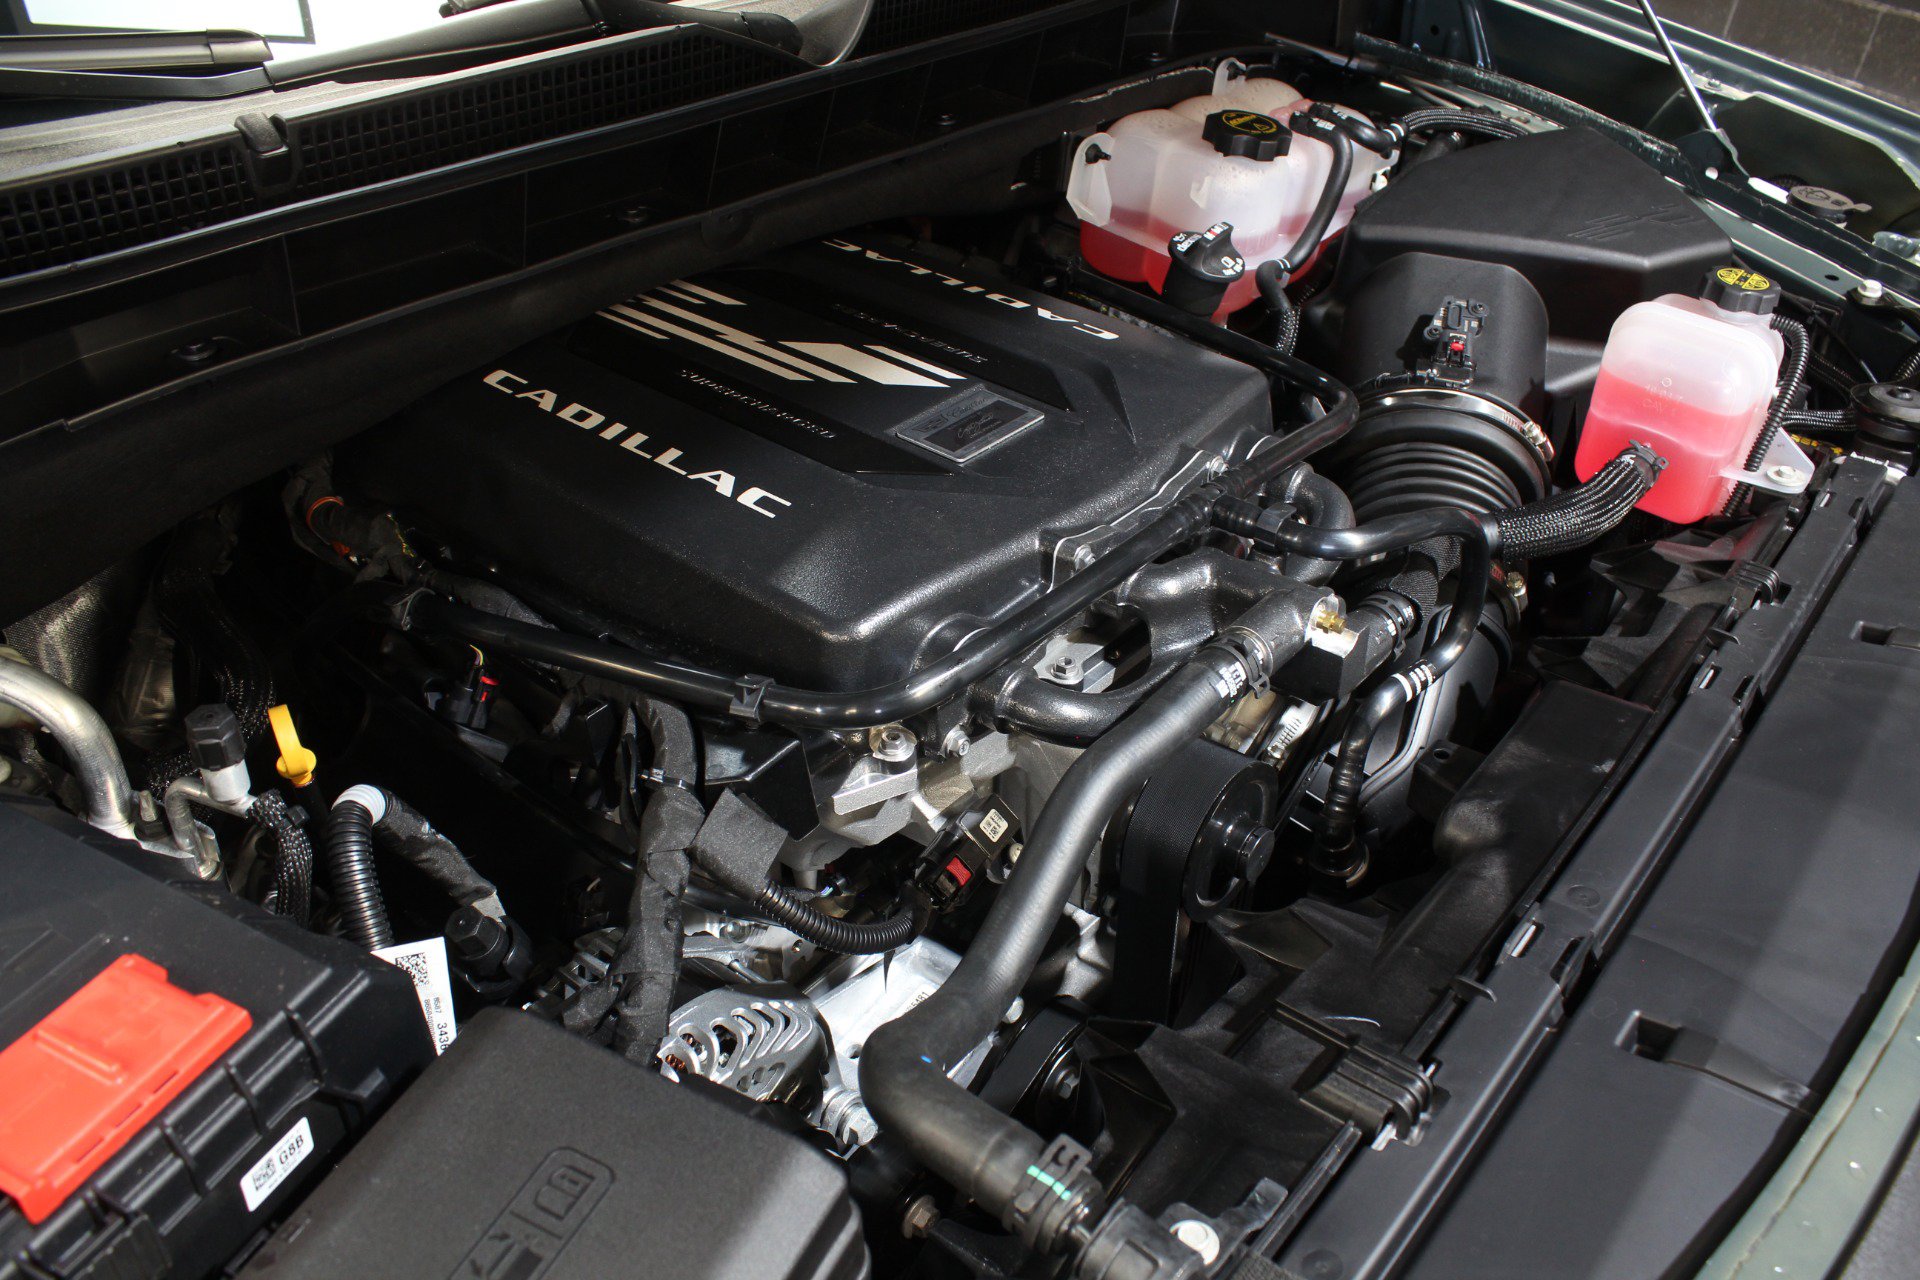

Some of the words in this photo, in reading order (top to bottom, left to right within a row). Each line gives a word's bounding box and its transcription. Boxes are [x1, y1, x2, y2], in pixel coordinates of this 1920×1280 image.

[821, 239, 1120, 340] CADILLAC
[482, 369, 792, 519] CADILLAC
[279, 1134, 304, 1165] G8B
